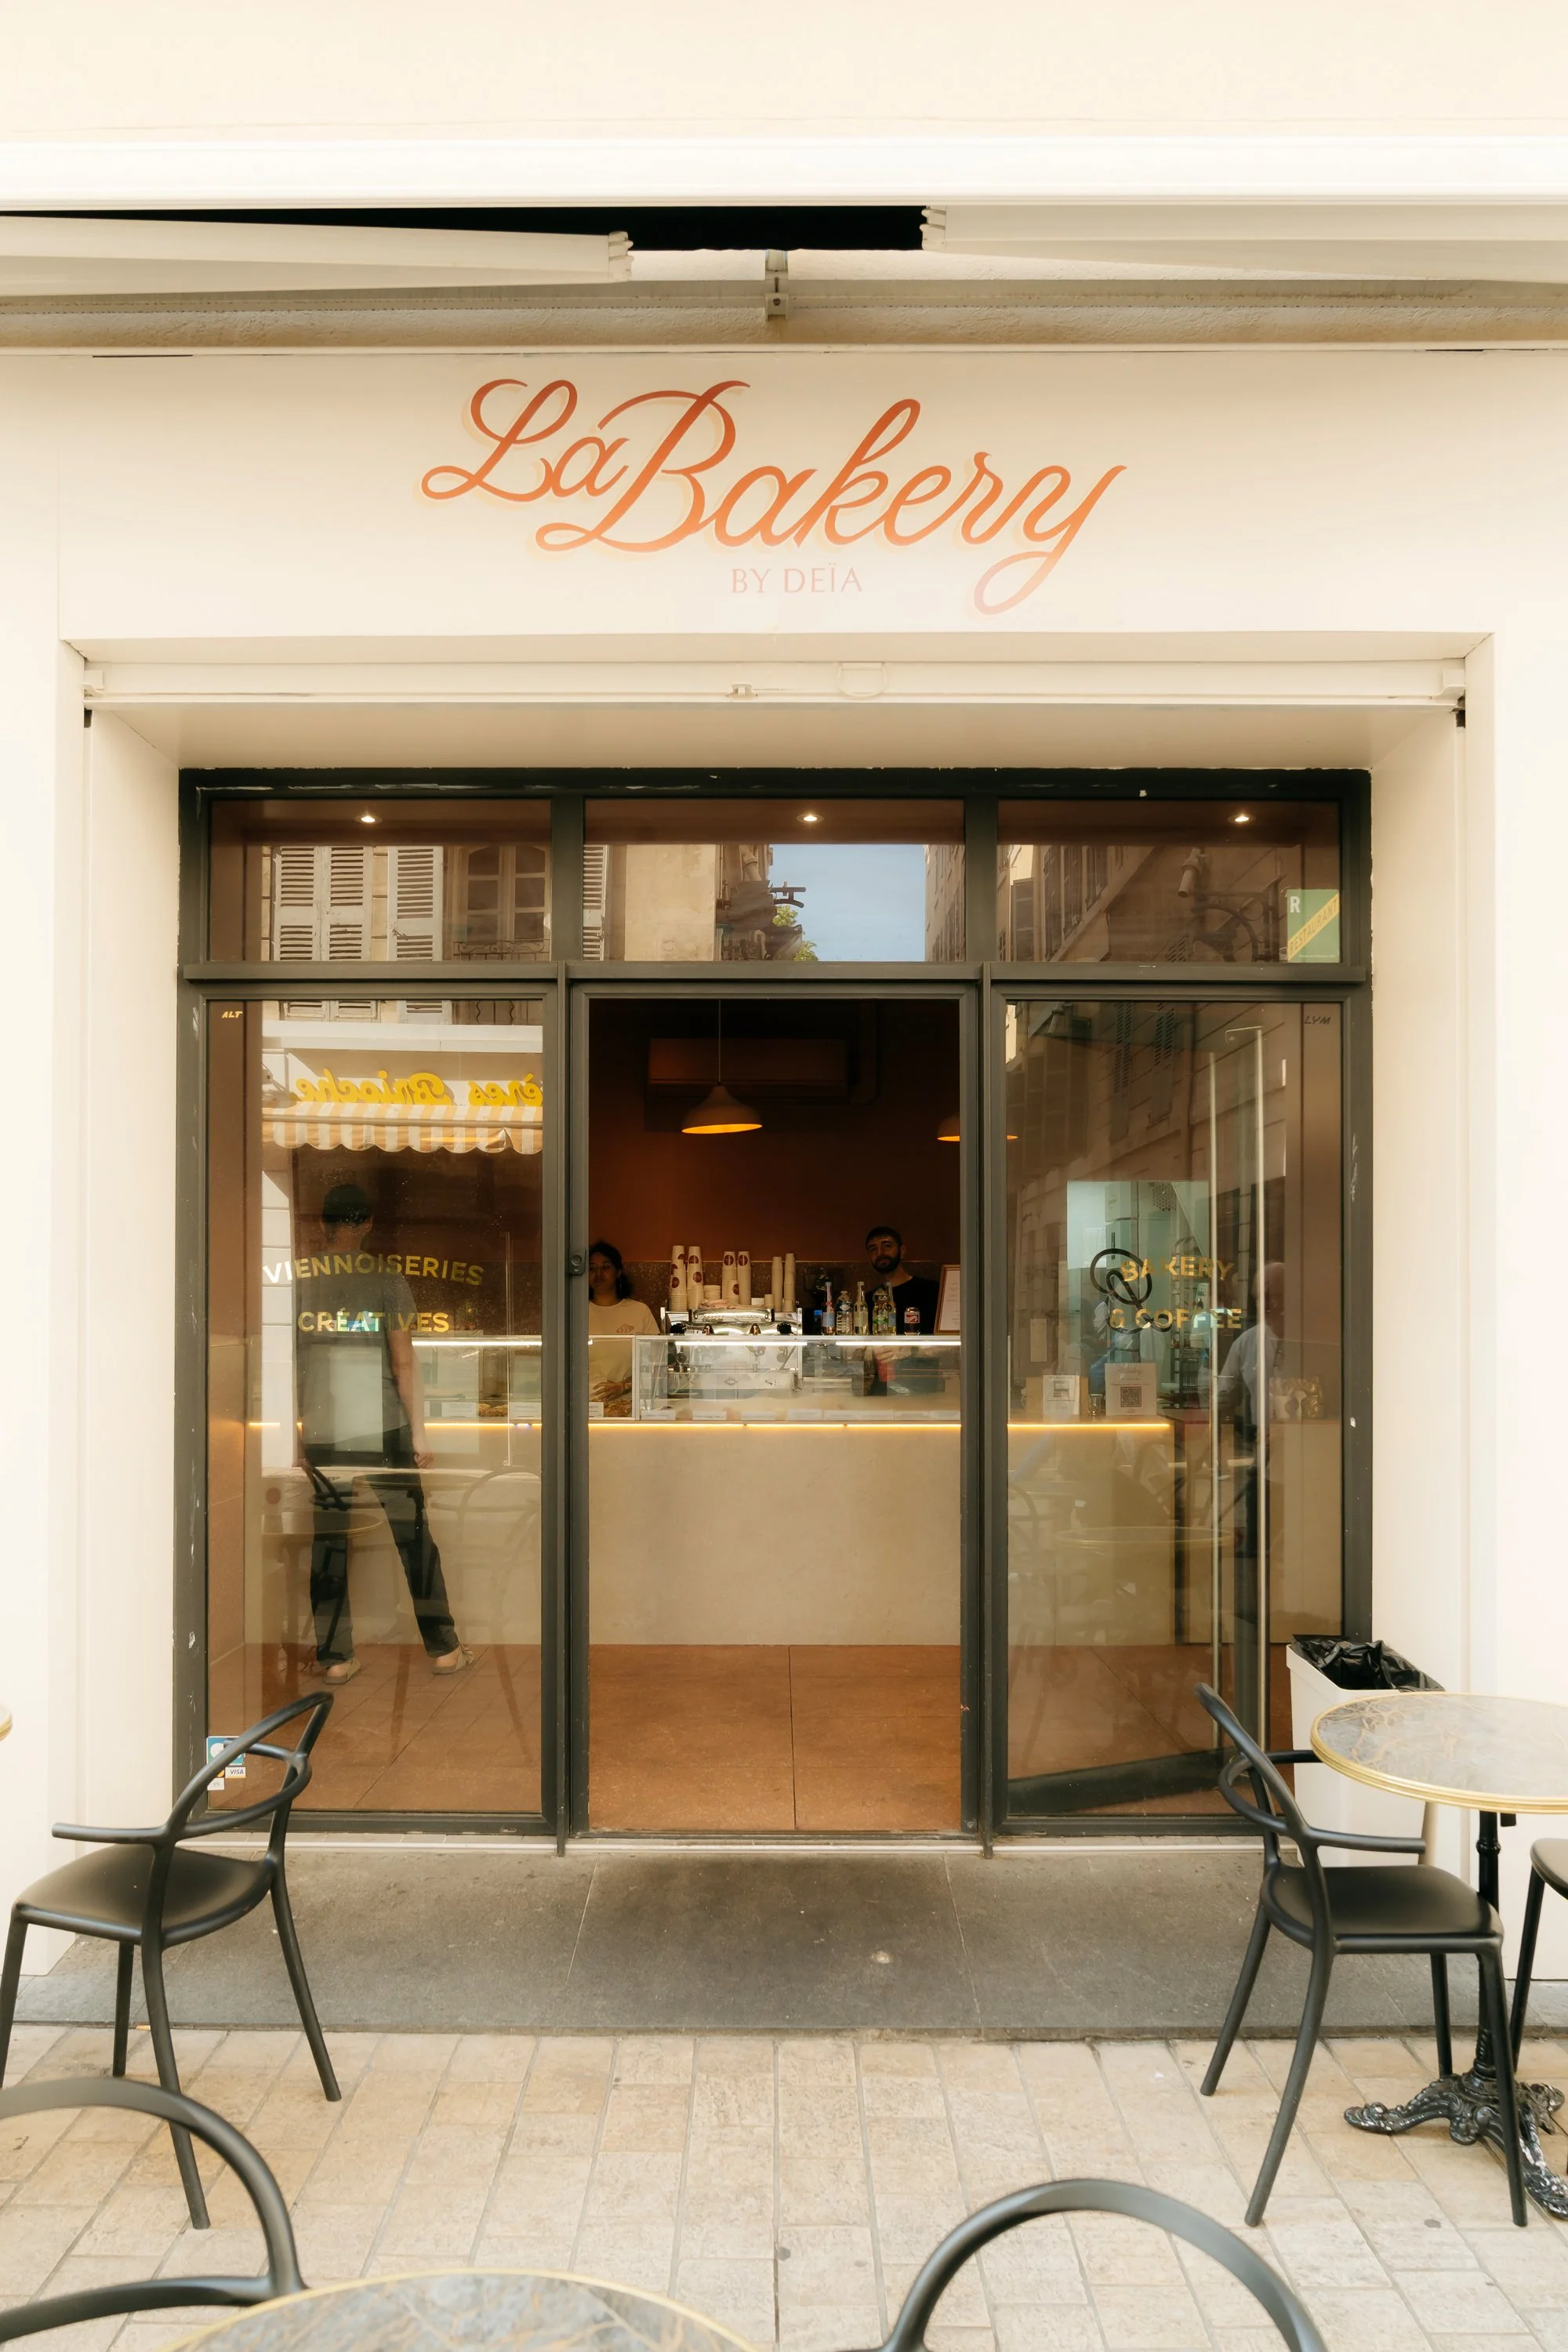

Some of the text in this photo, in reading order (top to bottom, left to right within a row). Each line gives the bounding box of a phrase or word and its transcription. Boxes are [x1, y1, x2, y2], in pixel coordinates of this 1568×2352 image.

[422, 379, 1127, 615] La Bakery
[731, 562, 863, 593] BY DEÏA
[1290, 895, 1301, 913] R
[1289, 898, 1338, 956] RESTAURANT
[263, 1254, 486, 1286] VIENNOISERIES
[1120, 1256, 1235, 1282] BAKERY
[297, 1308, 449, 1332] CRÉATIVES
[1135, 1308, 1242, 1329] COFFEE
